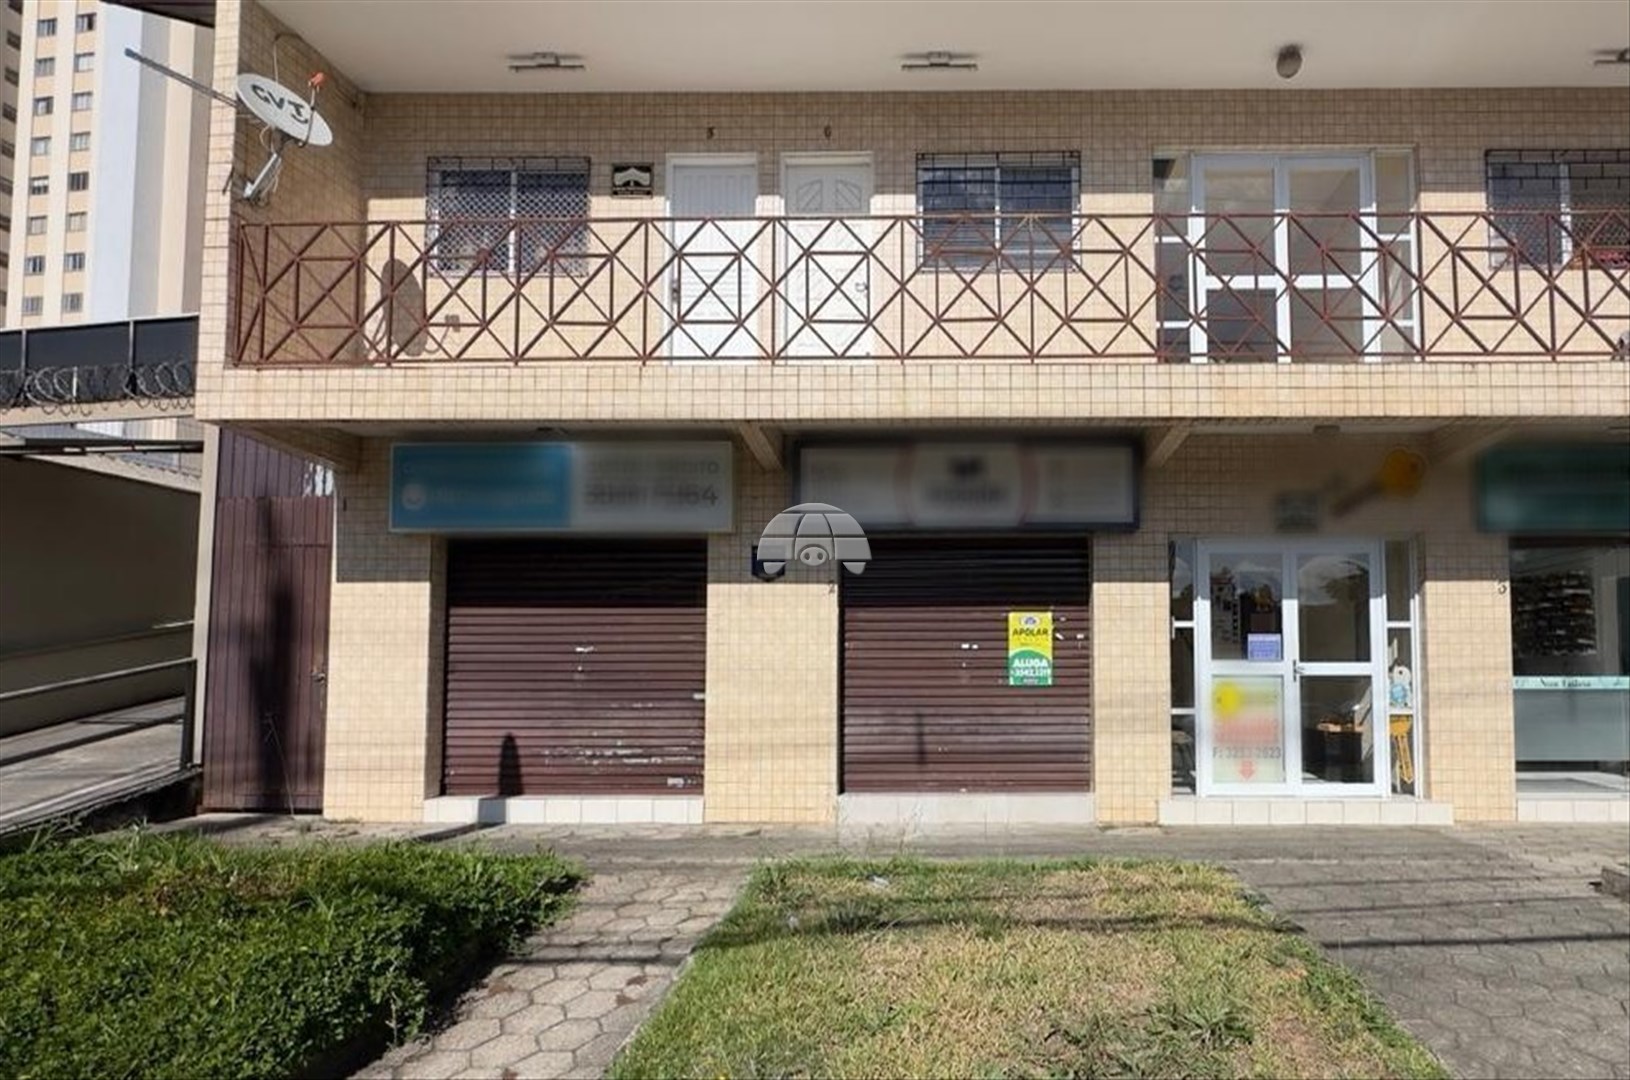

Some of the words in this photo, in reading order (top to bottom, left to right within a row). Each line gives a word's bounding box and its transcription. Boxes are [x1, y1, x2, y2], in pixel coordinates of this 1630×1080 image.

[251, 84, 305, 118] GVT
[1012, 627, 1049, 637] APOLAR
[1012, 658, 1048, 668] ALUGA
